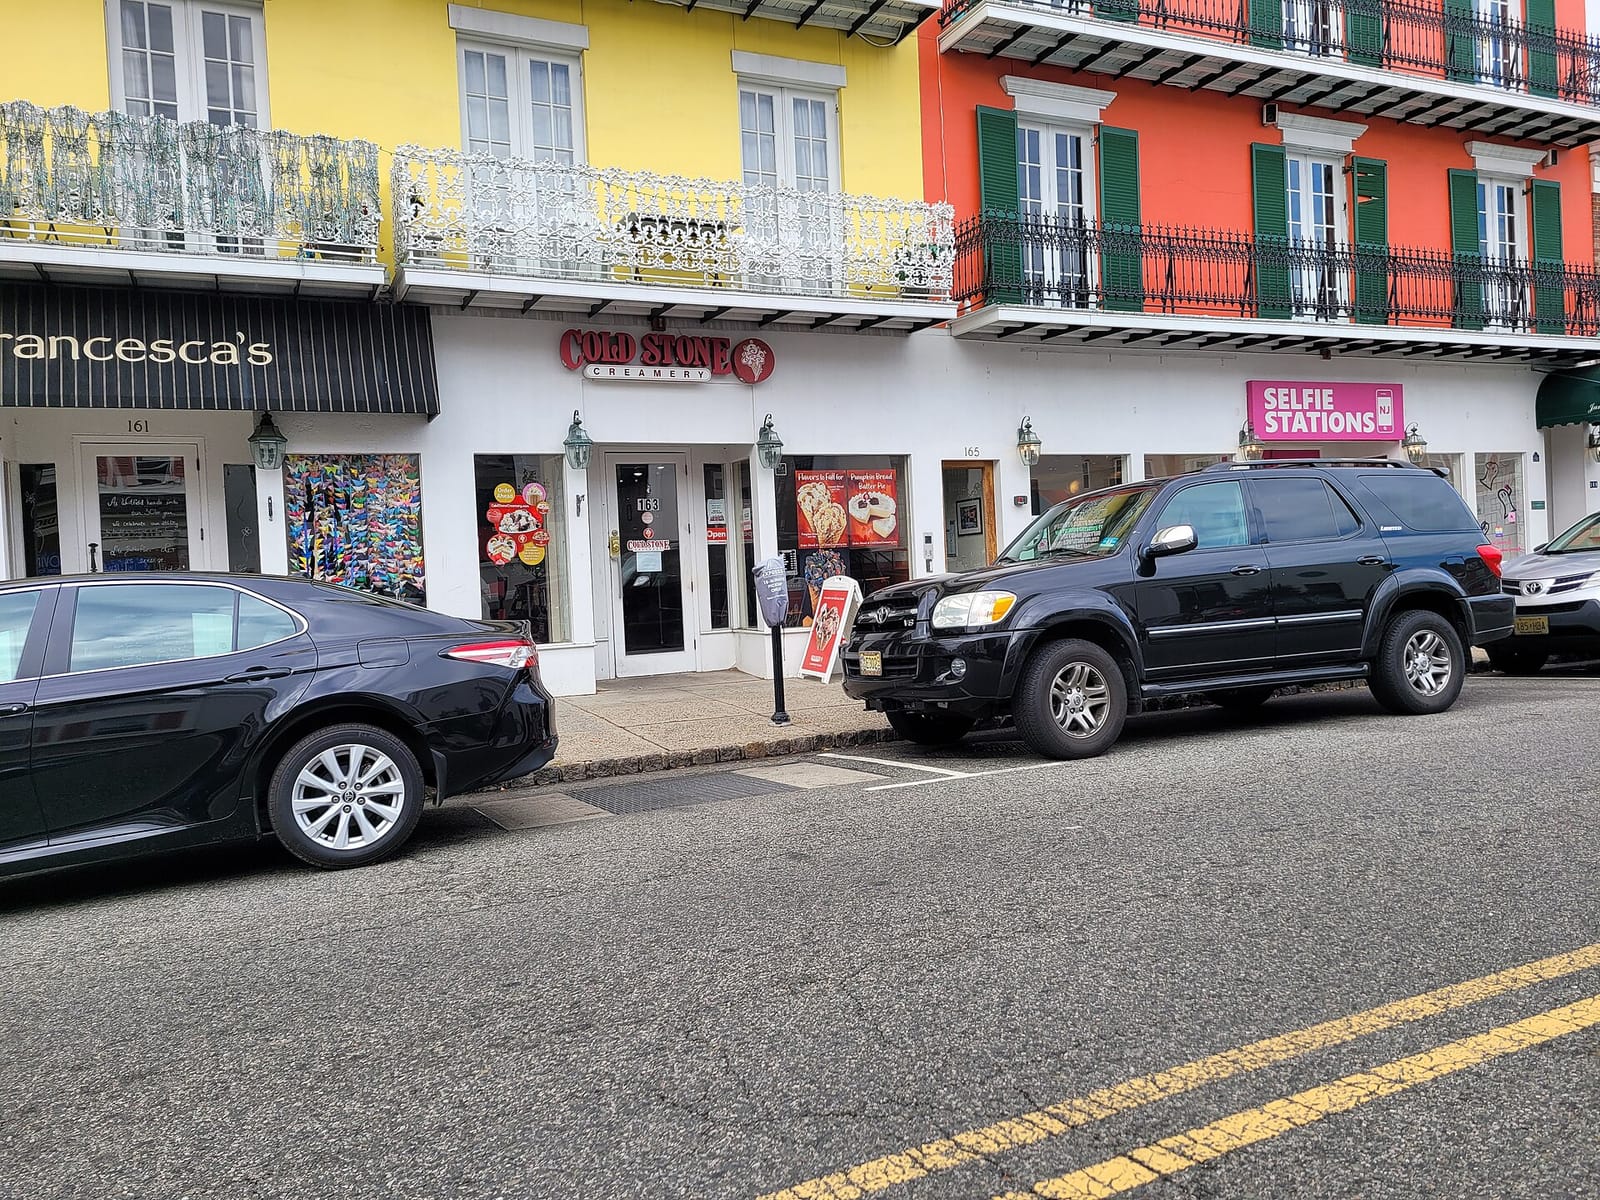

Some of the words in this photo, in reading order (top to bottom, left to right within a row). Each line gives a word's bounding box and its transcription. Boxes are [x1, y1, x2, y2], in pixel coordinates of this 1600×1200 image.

[560, 329, 637, 370] COLD
[640, 333, 732, 376] STONE
[593, 367, 705, 379] CREAMERY
[1263, 387, 1334, 410] SELFIE
[1379, 405, 1390, 415] NJ
[128, 420, 149, 433] 161
[1264, 411, 1375, 433] STATIONS
[964, 447, 980, 457] 165
[850, 473, 875, 483] Pumpkin
[876, 472, 893, 480] Bread
[638, 498, 659, 511] 163
[707, 530, 726, 540] Open
